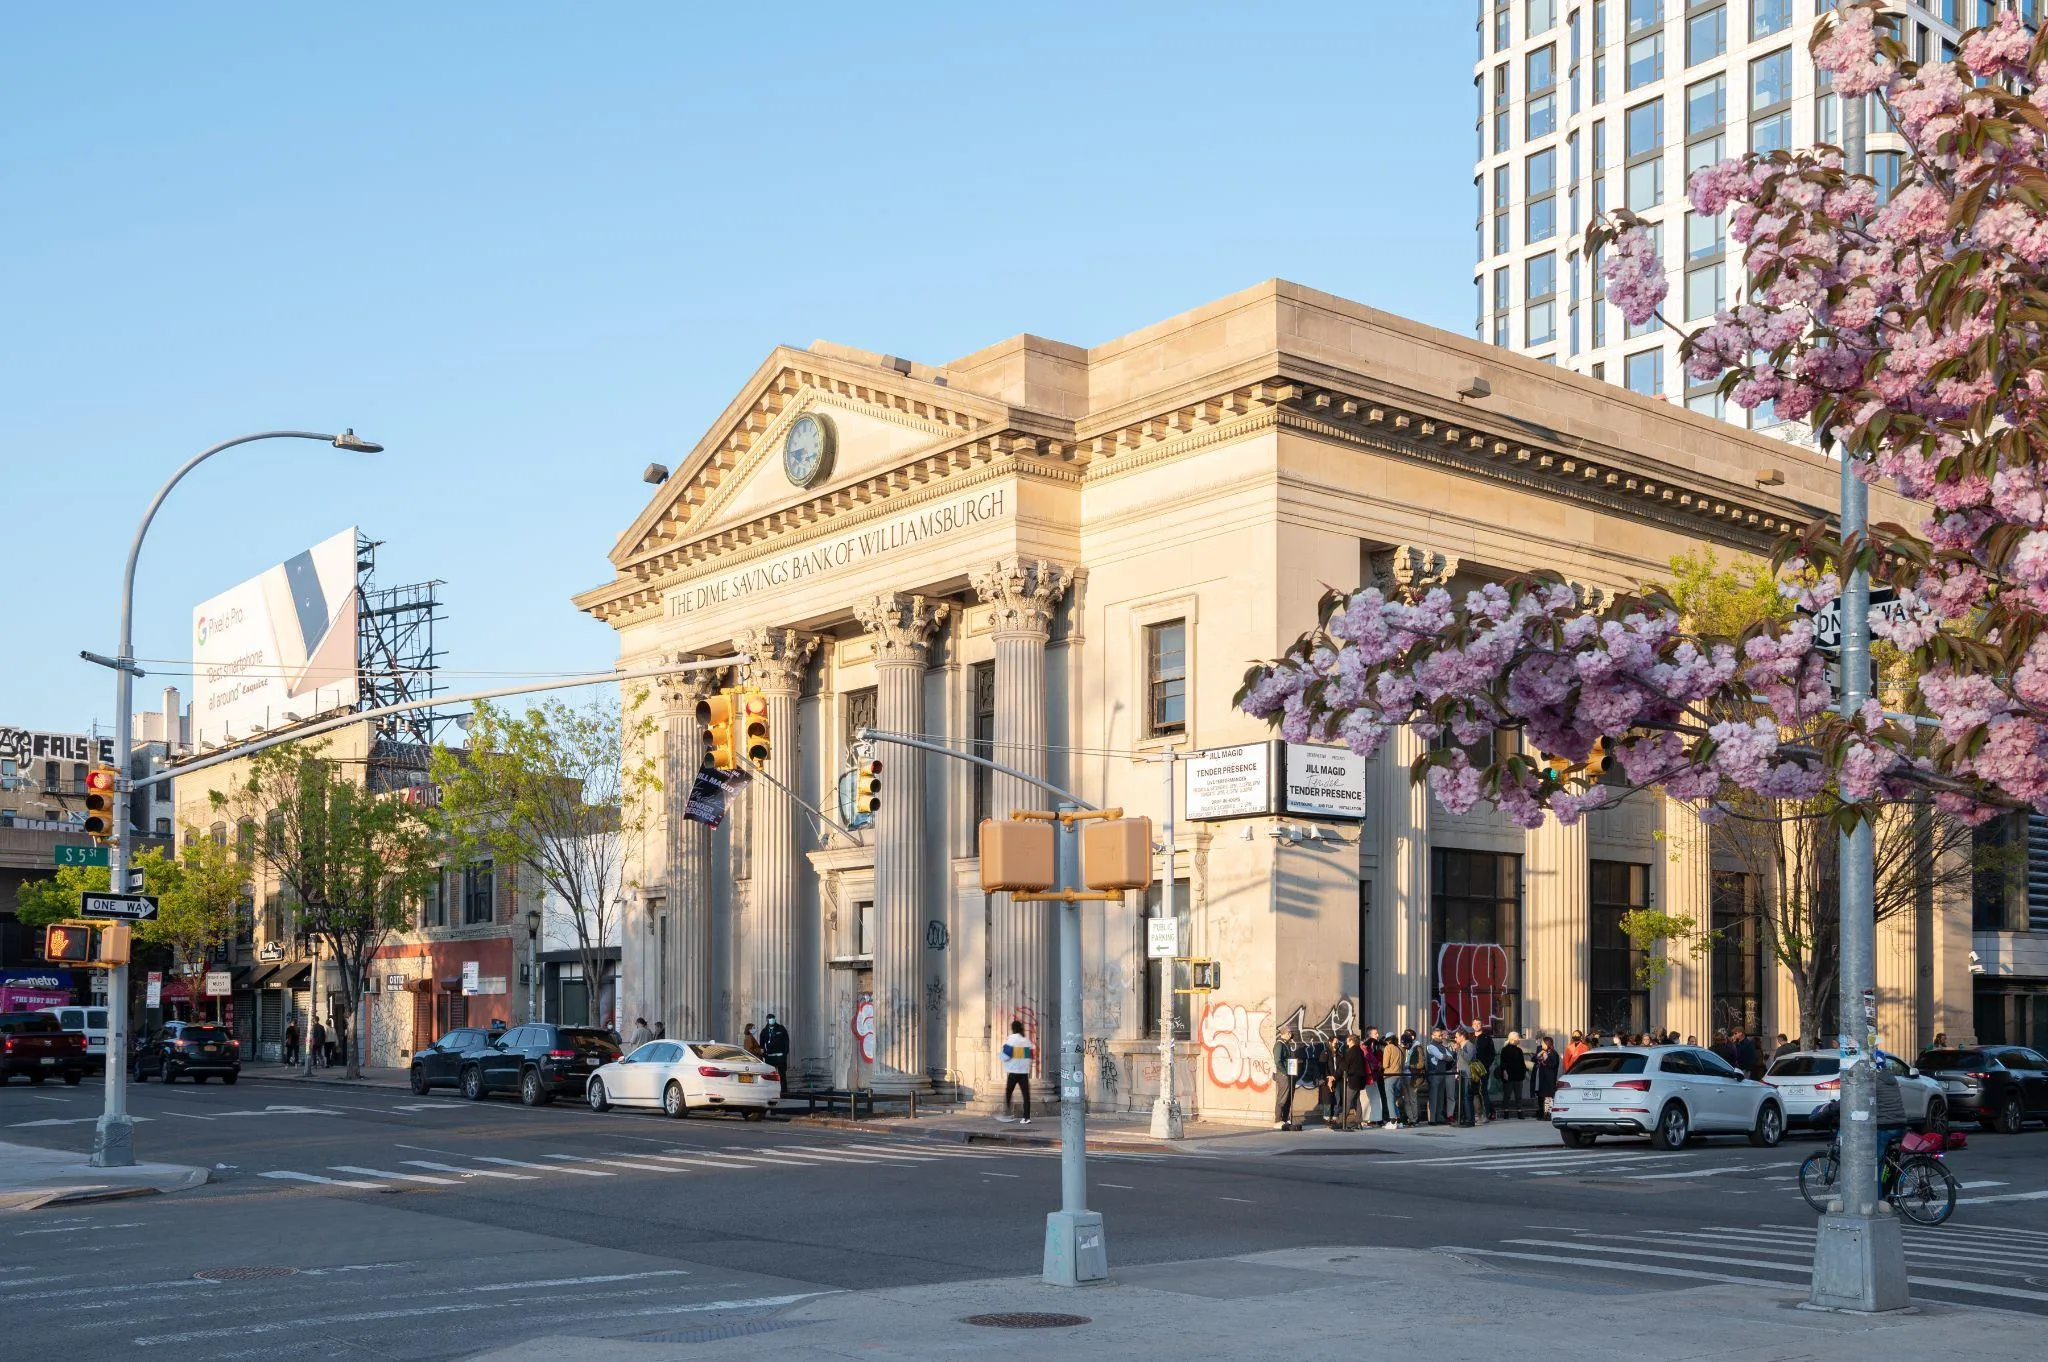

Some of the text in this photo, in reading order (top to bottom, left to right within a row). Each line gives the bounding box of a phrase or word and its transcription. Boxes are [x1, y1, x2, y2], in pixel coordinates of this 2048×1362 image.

[670, 489, 1003, 617] THE DIME SAVINGS BANK OF WILLIAMSBURGH
[208, 612, 224, 637] Pixel
[231, 607, 243, 626] Pro
[224, 648, 263, 678] smartphone
[242, 678, 269, 695] Esquire
[1221, 748, 1243, 757] MAGID
[1197, 763, 1257, 778] TENDER PRESENCE
[1305, 764, 1346, 776] JILL MAGID
[708, 777, 735, 793] MAGID
[1290, 785, 1362, 800] TENDER PRESENCE
[688, 800, 714, 813] TENDER
[65, 848, 73, 862] S
[79, 849, 86, 863] 5
[93, 900, 150, 912] ONE WAY
[1151, 933, 1175, 942] PARKING
[27, 976, 59, 986] metro
